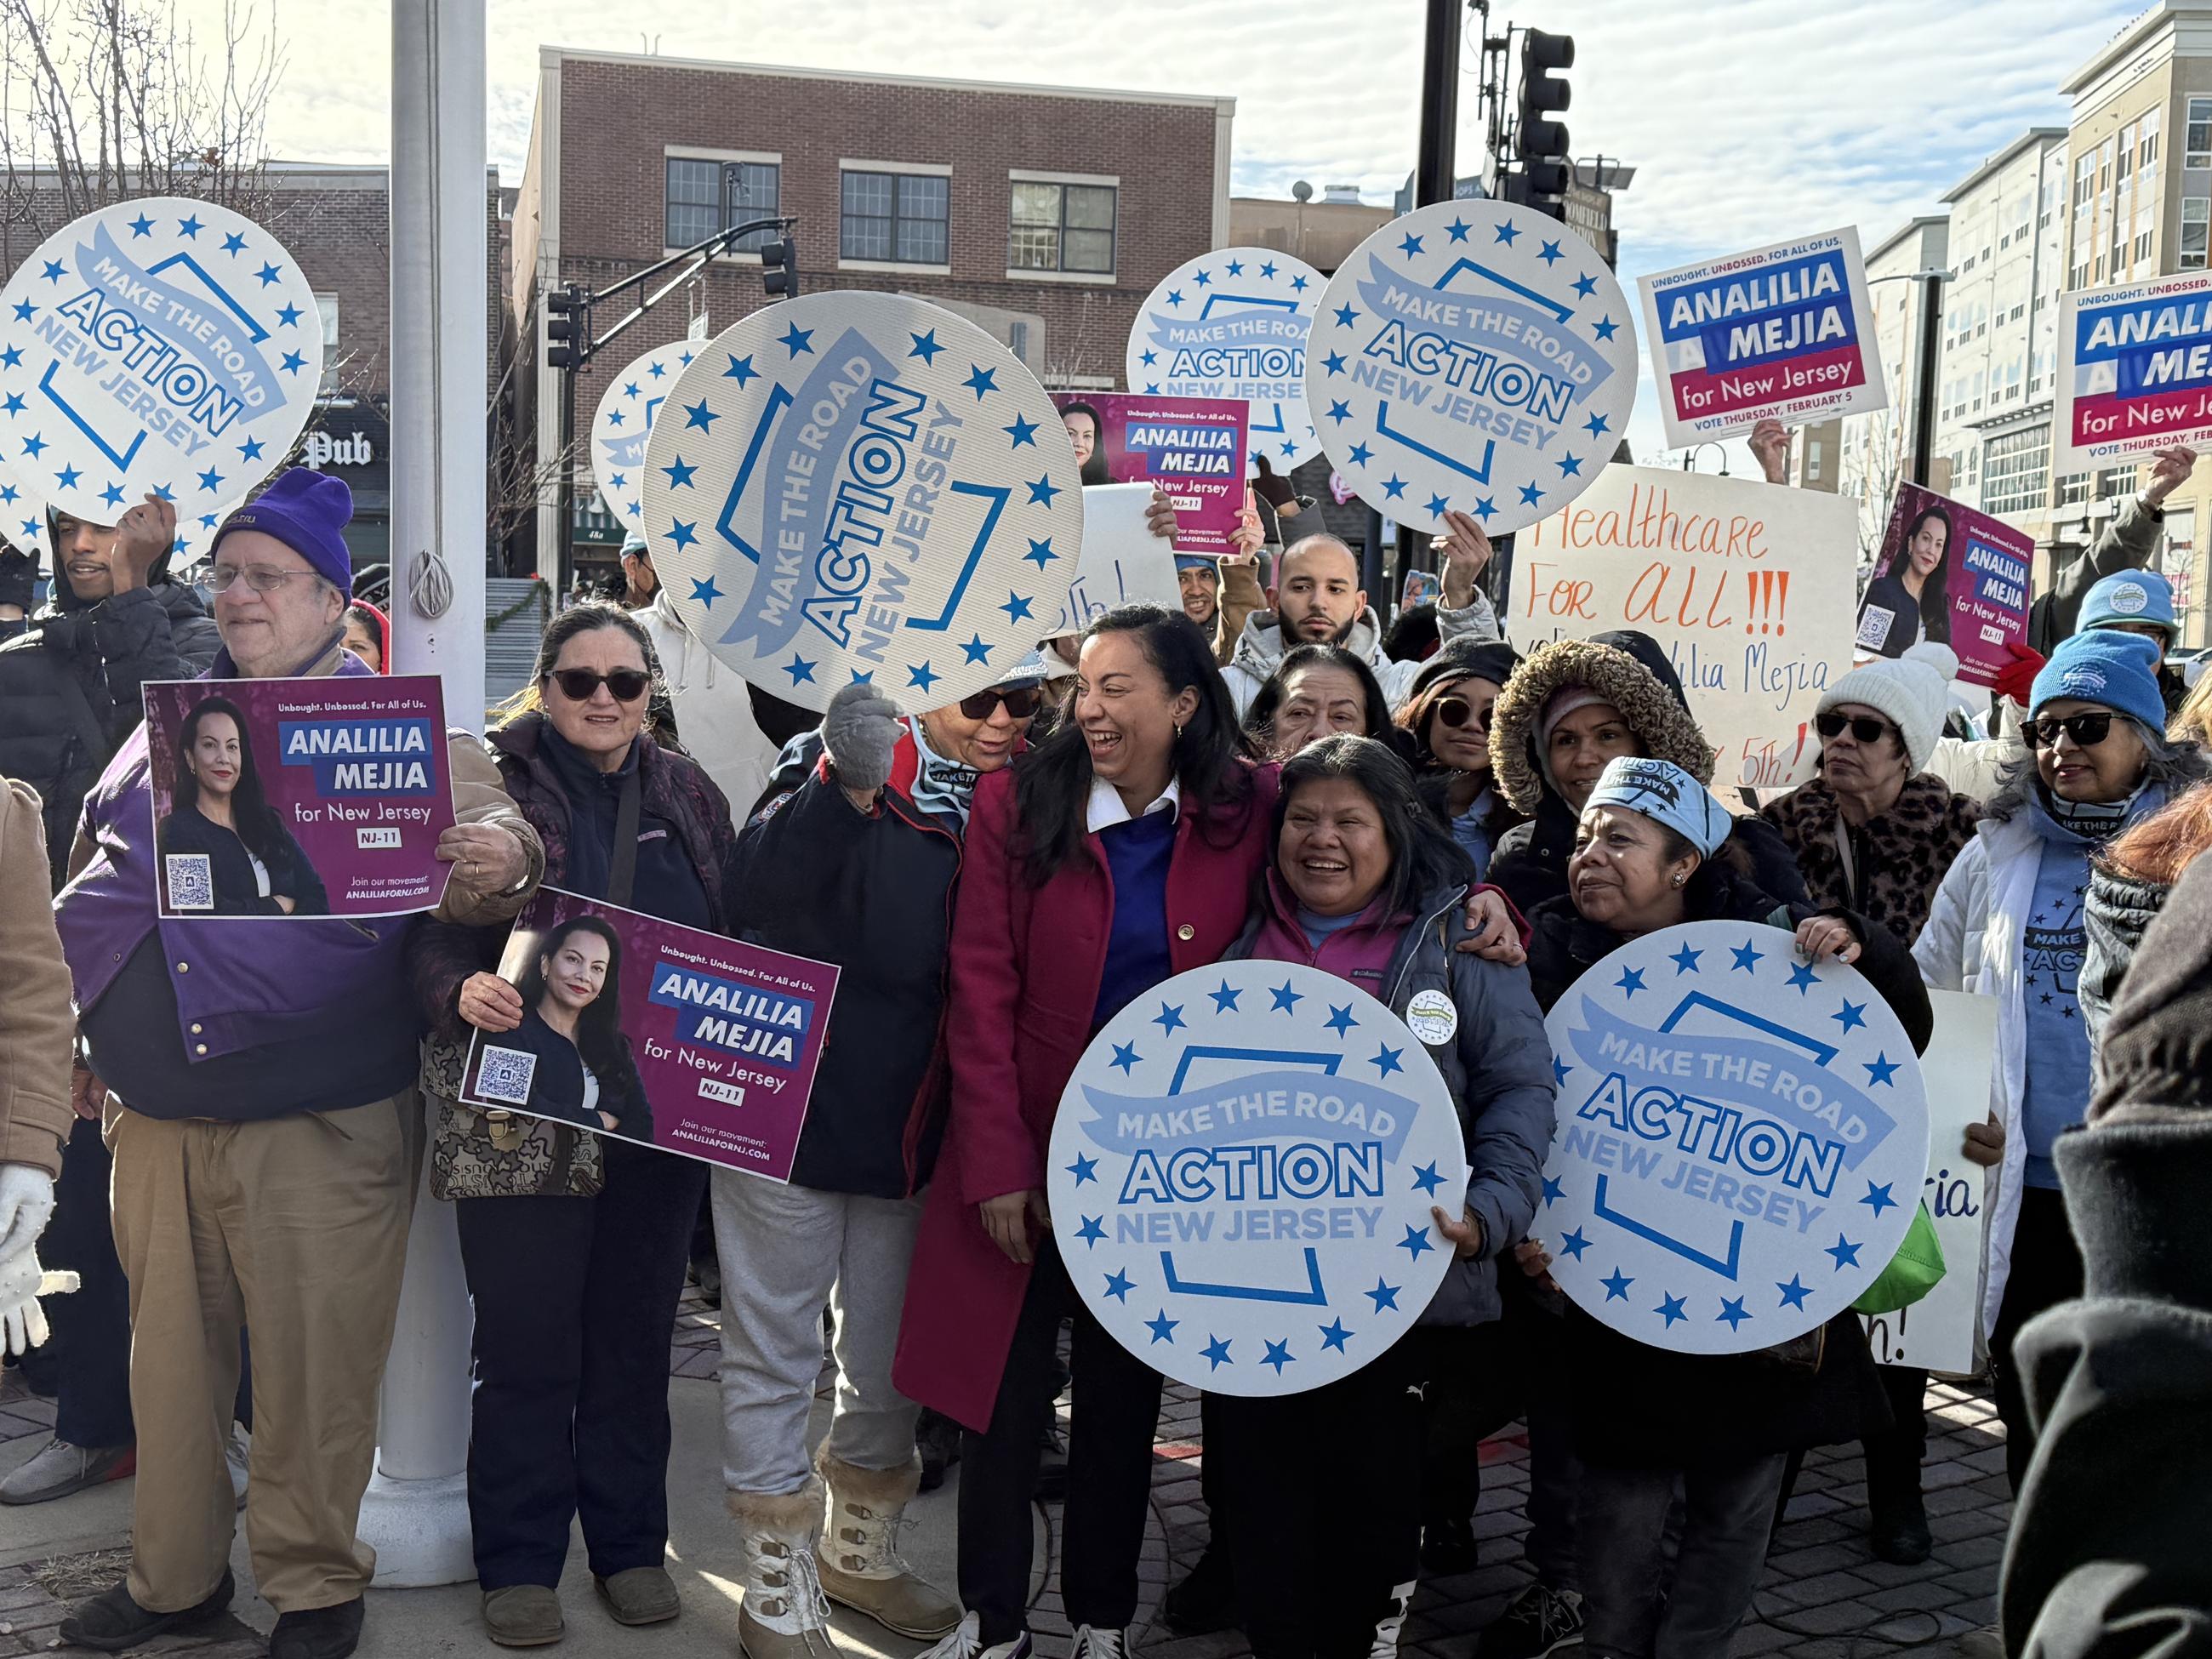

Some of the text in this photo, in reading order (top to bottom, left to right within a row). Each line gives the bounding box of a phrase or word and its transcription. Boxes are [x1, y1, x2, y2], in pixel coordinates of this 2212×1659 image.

[1651, 237, 1842, 288] UNBOUGHT. UNBOSSED. FOR ALL OF US.
[1668, 262, 1840, 330] ANALILIA
[2078, 279, 2211, 306] UNBOUGHT. UNBOSSED.
[92, 257, 266, 408] MAKE THE ROAD
[1169, 319, 1311, 343] MAKE THE ROA
[1382, 285, 1593, 385] MAKE THE ROAD
[1728, 305, 1847, 362] MEJIA
[55, 287, 245, 438] ACTION
[1363, 319, 1576, 425] ACTION
[34, 315, 212, 458] NEW JERSEY
[1166, 382, 1302, 399] NEW JERSE
[1350, 359, 1558, 451] NEW JERSEY
[1683, 361, 1852, 410] for New Jersey
[1695, 391, 1852, 430] VOTE THURSDAY, FEBRUARY 5
[2083, 410, 2118, 436] for
[2128, 403, 2187, 428] New
[299, 430, 371, 470] Pub
[1130, 427, 1233, 449] ANALILIA
[2089, 445, 2119, 457] VOTE
[2123, 434, 2189, 452] THURSDAY,
[1160, 452, 1230, 473] MEJIA
[759, 355, 872, 626] MAKE THE ROAD
[1153, 478, 1183, 492] New
[1187, 480, 1229, 497] Jersey
[801, 379, 927, 648] ACTION
[855, 400, 964, 664] NEW JERSEY
[1967, 546, 2025, 586] ANALILIA
[1982, 578, 2023, 610] MEJIA
[1956, 596, 2021, 635] for New Jersey
[278, 703, 322, 713] Unbought.
[325, 702, 369, 711] Unbossed.
[371, 701, 385, 710] For
[387, 700, 399, 709] All
[402, 699, 411, 709] of
[288, 727, 425, 754] ANALILIA
[334, 761, 428, 790] MEJIA
[1633, 776, 1671, 795] MAKE
[295, 802, 430, 824] for New Jersey
[361, 832, 396, 844] NJ-11
[346, 887, 430, 899] ANALILIAFORNJ.COM
[351, 876, 368, 887] Join
[371, 877, 385, 886] our
[2033, 932, 2081, 945] MAKE
[660, 944, 708, 964] Unbought.
[710, 958, 756, 978] Unbossed.
[759, 972, 774, 982] For
[775, 975, 788, 986] All
[801, 982, 816, 992] Us.
[658, 973, 801, 1029] ANALILIA
[694, 1016, 792, 1062] MEJIA
[644, 1038, 787, 1094] for New Jersey
[702, 1082, 739, 1101] NJ-11
[1598, 1031, 1868, 1144] MAKE THE ROAD
[681, 1119, 698, 1131] Join
[701, 1125, 716, 1135] our
[1117, 1090, 1396, 1140] MAKE THE ROAD
[672, 1129, 770, 1161] ANALILIAFORNJ.COM
[1577, 1071, 1845, 1199] ACTION
[1118, 1141, 1383, 1204] ACTION
[1563, 1124, 1825, 1235] NEW JERSEY
[1116, 1206, 1383, 1244] NEW JERSEY
